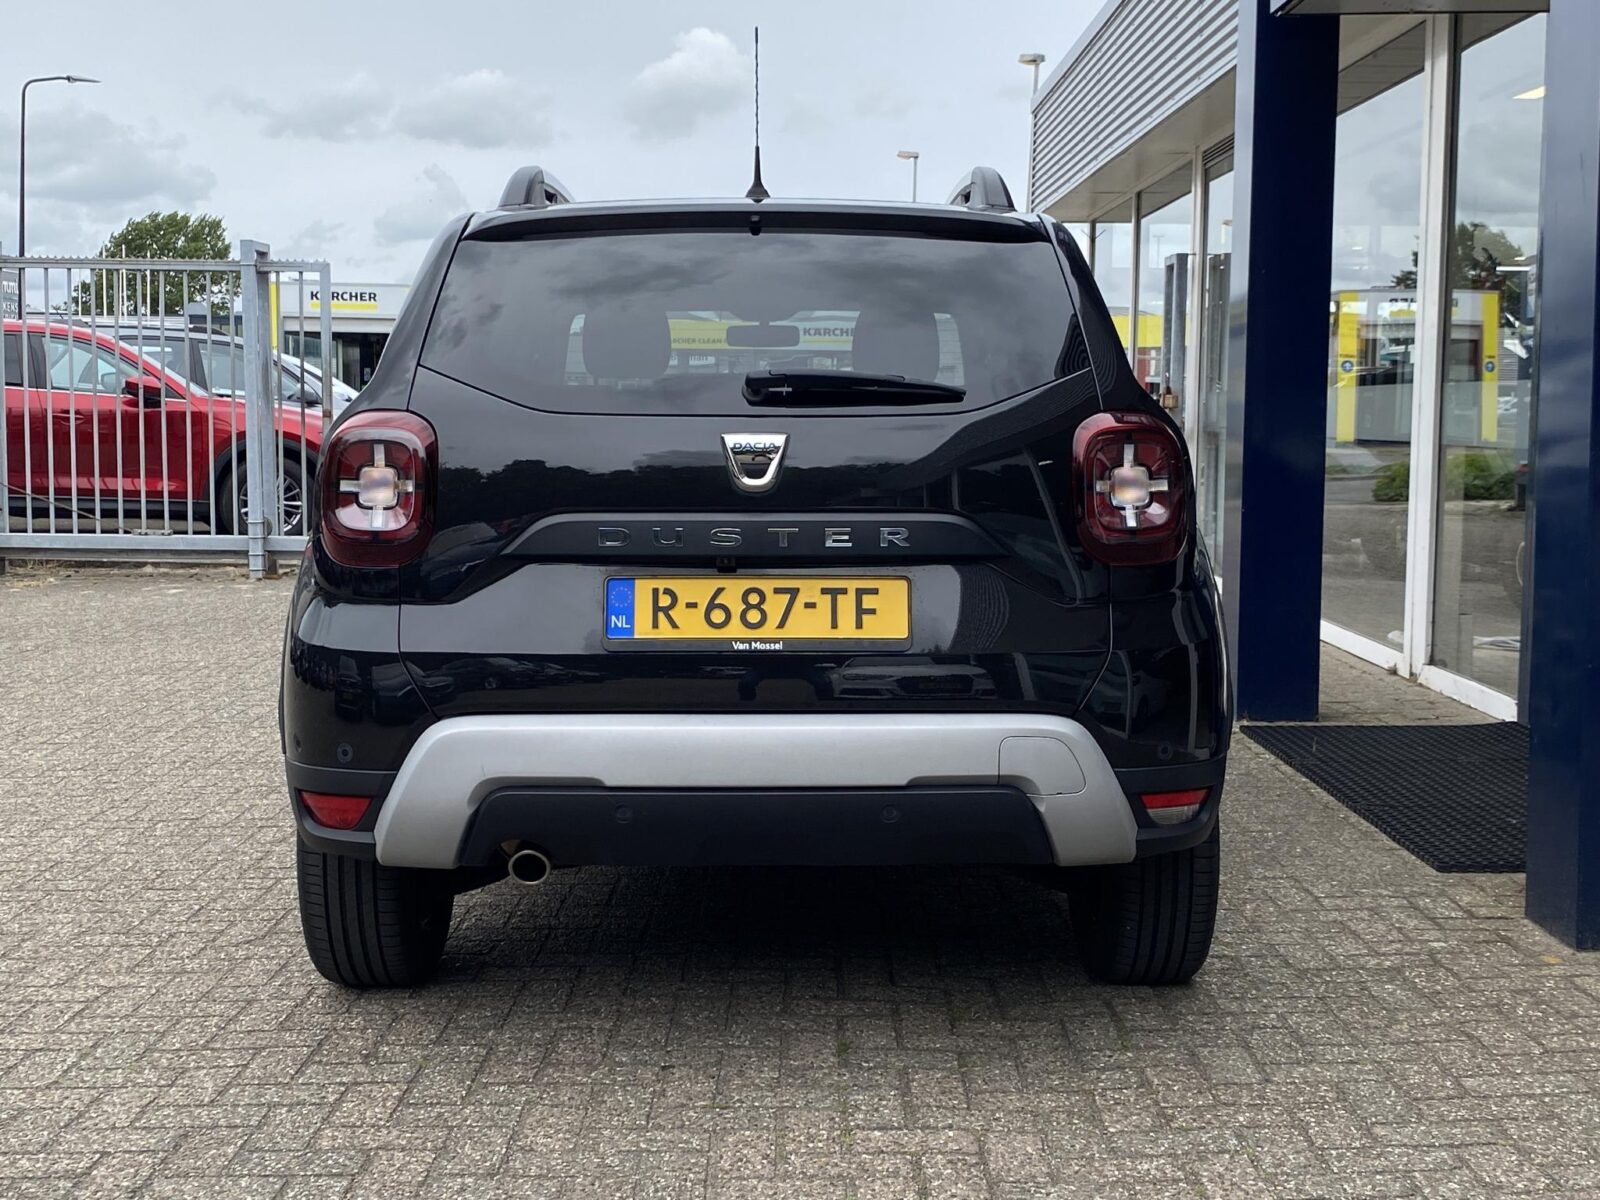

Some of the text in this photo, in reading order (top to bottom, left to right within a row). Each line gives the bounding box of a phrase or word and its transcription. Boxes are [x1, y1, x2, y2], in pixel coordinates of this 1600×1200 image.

[310, 291, 378, 302] KRCHER
[733, 443, 778, 452] DACIA
[598, 527, 911, 547] DUSTER
[651, 587, 880, 630] R-687-TF
[611, 615, 631, 628] NL
[731, 640, 783, 650] Van Mossel
